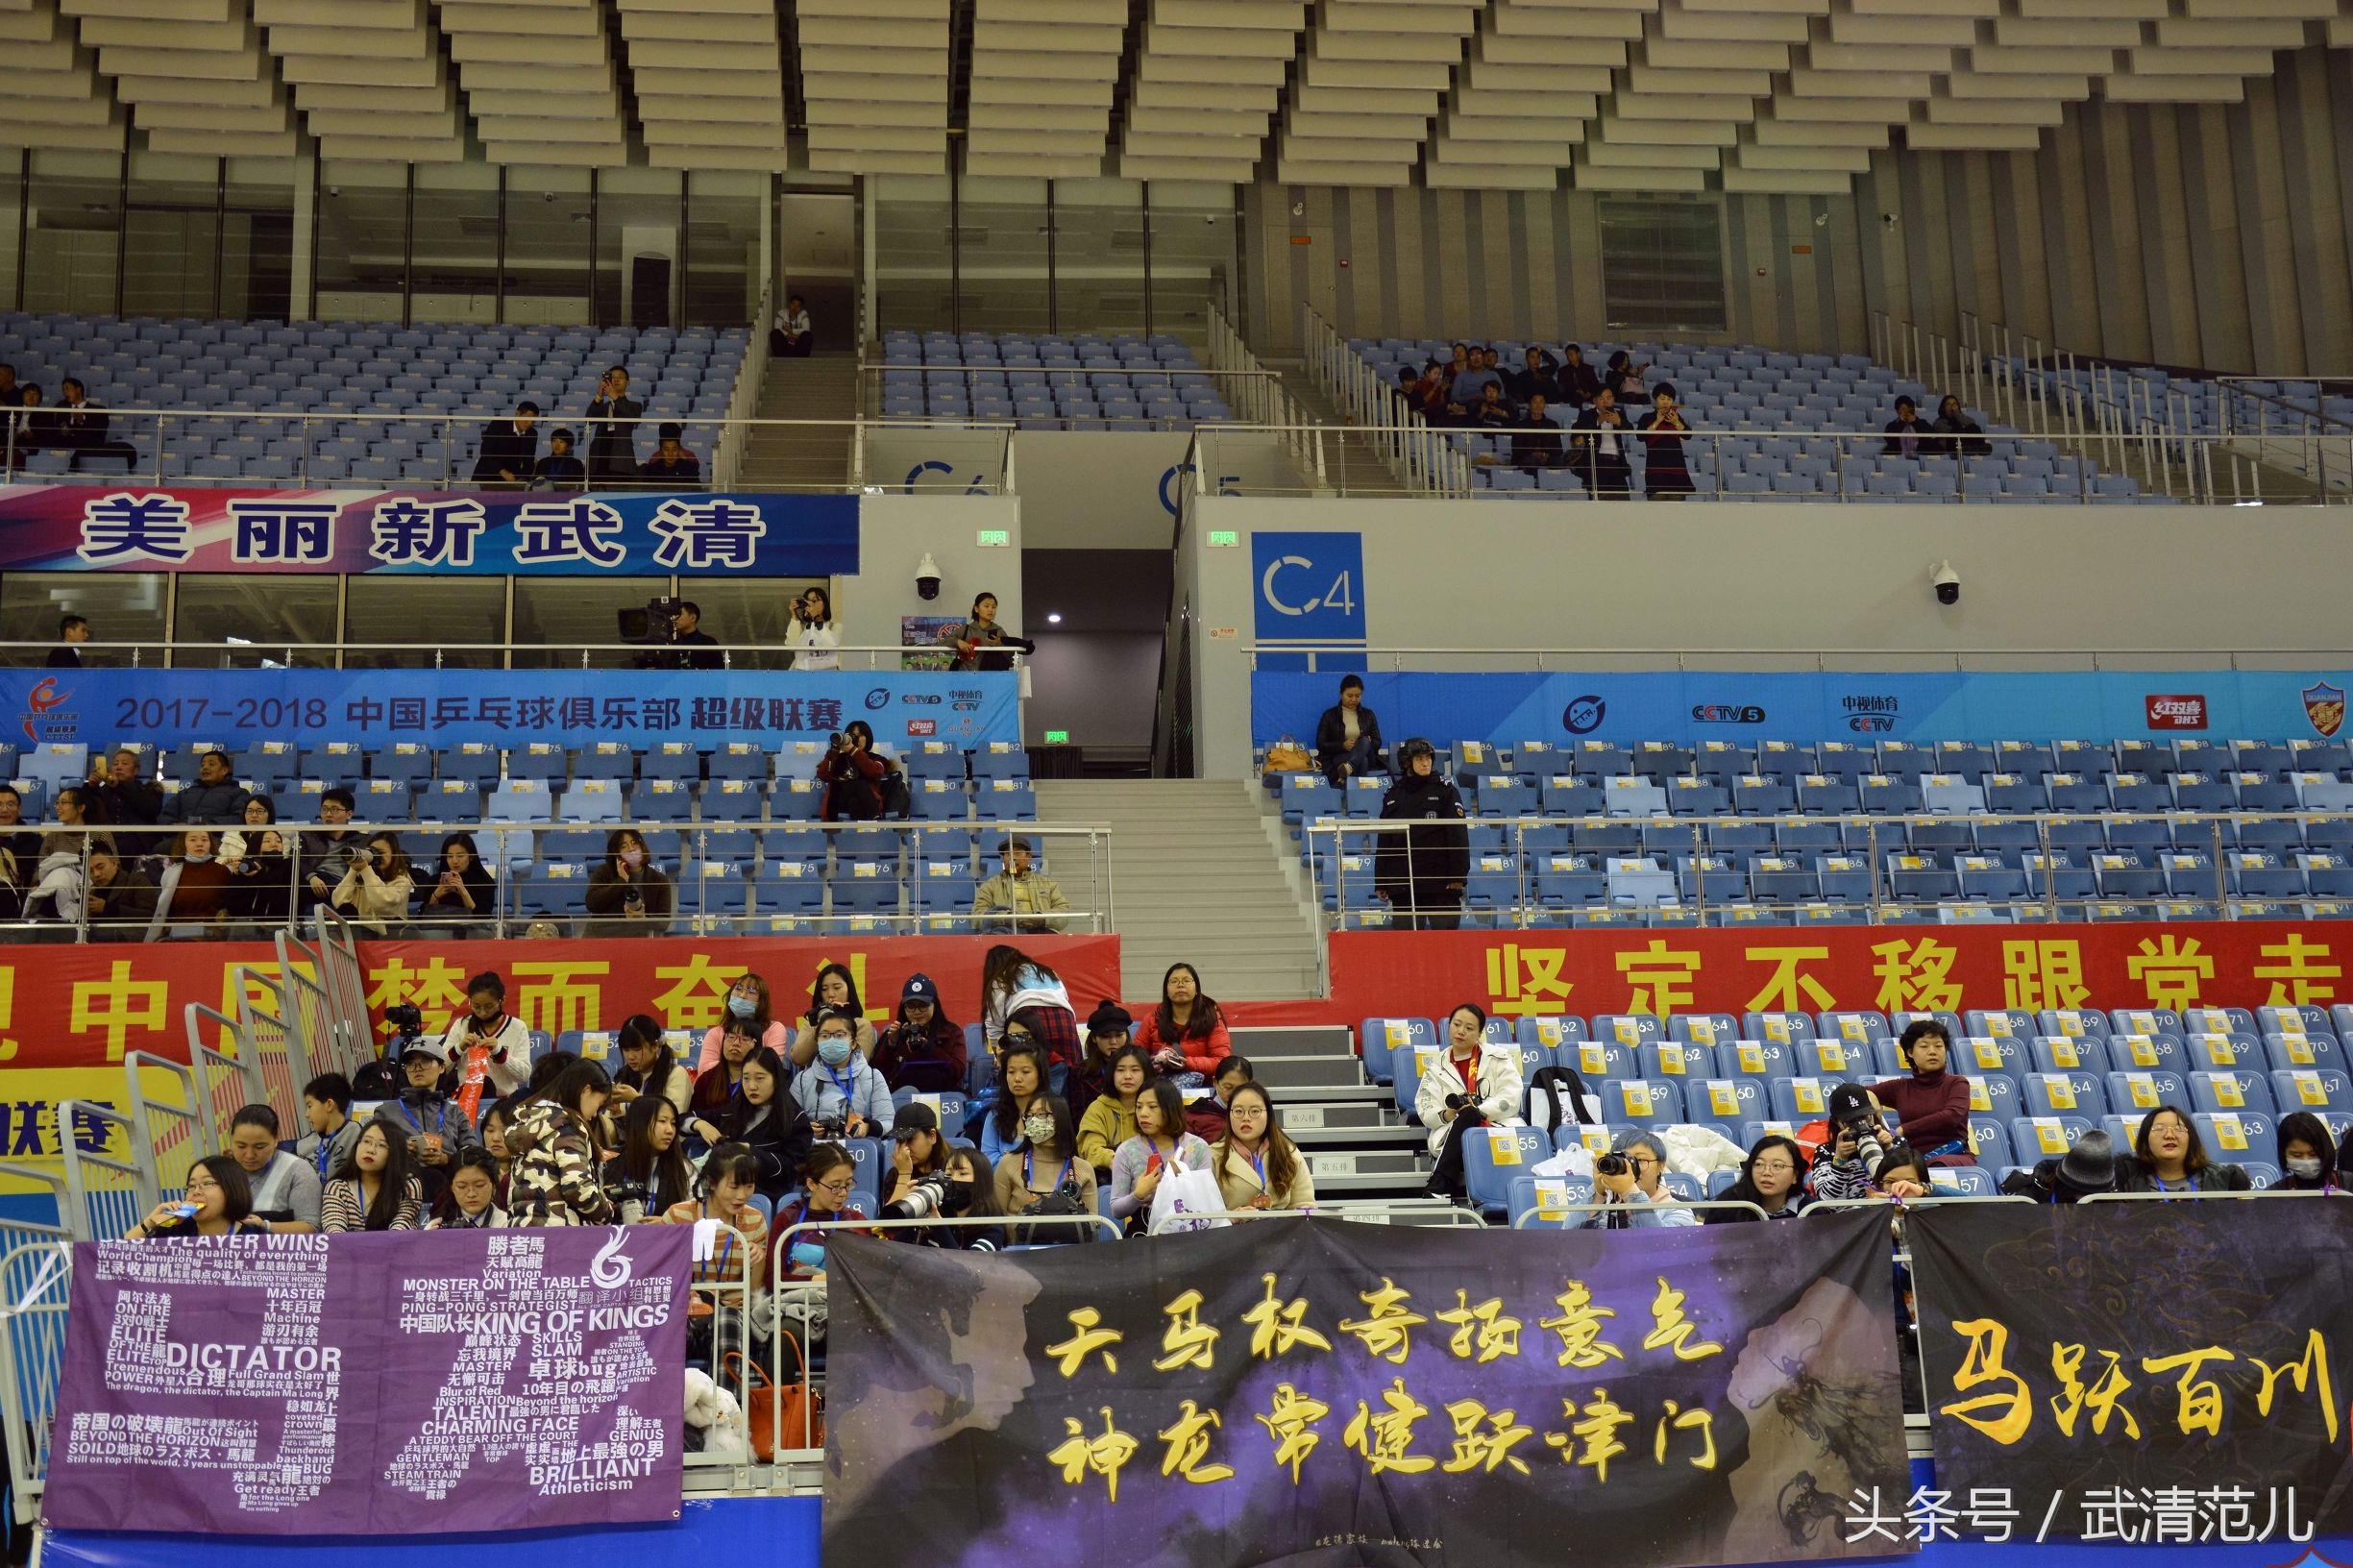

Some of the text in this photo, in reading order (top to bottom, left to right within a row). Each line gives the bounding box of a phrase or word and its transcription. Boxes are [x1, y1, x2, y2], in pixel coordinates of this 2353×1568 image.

[78, 493, 768, 568] 美丽新武清
[1263, 555, 1355, 616] C4
[952, 702, 979, 711] CCTV
[1842, 696, 1899, 712] 中视体育
[2151, 699, 2203, 720] 红双喜
[115, 695, 844, 733] 2017-2018 中国乒乓球俱乐部 超级联赛
[2173, 715, 2200, 724] DHS
[1850, 718, 1895, 732] CCTV
[723, 864, 738, 873] 74
[1572, 859, 1585, 869] 82
[1486, 933, 2342, 1024] 坚定不移跟党走
[2009, 1017, 2024, 1027] 68
[2302, 1012, 2320, 1023] 72
[1409, 1024, 1423, 1034] 60
[1638, 1021, 1654, 1032] 63
[1787, 1019, 1803, 1030] 65
[1998, 1045, 2014, 1056] 66
[2310, 1041, 2328, 1053] 70
[1651, 1088, 1668, 1100] 59
[2072, 1082, 2091, 1093] 64
[942, 1103, 959, 1115] 53
[2243, 1122, 2264, 1136] 63
[1518, 1138, 1537, 1150] 55
[1960, 1178, 1978, 1191] 57
[266, 1234, 330, 1252] WINS
[97, 1250, 192, 1263] World Champion
[170, 1247, 328, 1263] The quality of everything
[97, 1260, 173, 1278] 记录收割机
[482, 1268, 542, 1279] Variation
[403, 1276, 591, 1291] MONSTER ON THE TABLE
[628, 1276, 673, 1287] TACTICS
[117, 1289, 172, 1306] 阿尔法龙
[267, 1287, 326, 1300] MASTER
[578, 1288, 644, 1305] 翻译小组
[115, 1303, 171, 1316] ON FIRE
[266, 1299, 322, 1313] 十年百冠
[402, 1302, 486, 1313] PING-PONG
[489, 1300, 578, 1312] STRATEGIST
[264, 1312, 321, 1324] Machine
[400, 1313, 475, 1334] 中国队长
[474, 1303, 670, 1335] KING OF KINGS
[110, 1324, 167, 1344] ELITE
[262, 1323, 319, 1337] 游刃有余
[465, 1334, 522, 1347] 巅峰状态
[532, 1331, 582, 1344] SKILLS
[107, 1348, 150, 1364] ELITE
[166, 1342, 342, 1372] DICTATOR
[457, 1347, 517, 1362] 忘我境界
[531, 1343, 582, 1358] SLAM
[106, 1360, 186, 1376] Tremendous
[453, 1361, 512, 1373] MASTER
[105, 1371, 154, 1384] POWER
[155, 1375, 186, 1385] 外星人
[186, 1366, 226, 1387] 合理
[228, 1370, 325, 1381] Full Grand Slam
[448, 1372, 505, 1386] 无懈可击
[1941, 1317, 2339, 1445] 马跃百川
[439, 1385, 502, 1397] Blur of Red
[285, 1400, 327, 1413] 稳如龙
[435, 1394, 516, 1408] INSPIRATION
[515, 1393, 618, 1408] Beyond the horizon
[432, 1405, 510, 1421] TALENT
[421, 1416, 579, 1436] CHARMING FACE
[70, 1431, 221, 1447] BEYOND THE HORIZON
[183, 1427, 258, 1439] Out Of Sight
[409, 1432, 577, 1445] A TEDDY BEAR OFF THE COURT
[609, 1429, 665, 1442] GENIUS
[1046, 1376, 1718, 1503] 神龙常健跃津门
[68, 1442, 116, 1455] SOILD
[279, 1445, 335, 1455] Thunderous
[276, 1454, 335, 1464] backhand
[396, 1453, 470, 1462] GENTLEMAN
[304, 1464, 332, 1475] BUG
[384, 1469, 462, 1481] STEAM TRAIN
[529, 1457, 656, 1486] BRILLIANT
[234, 1483, 297, 1497] Get ready
[538, 1479, 633, 1497] Athleticism
